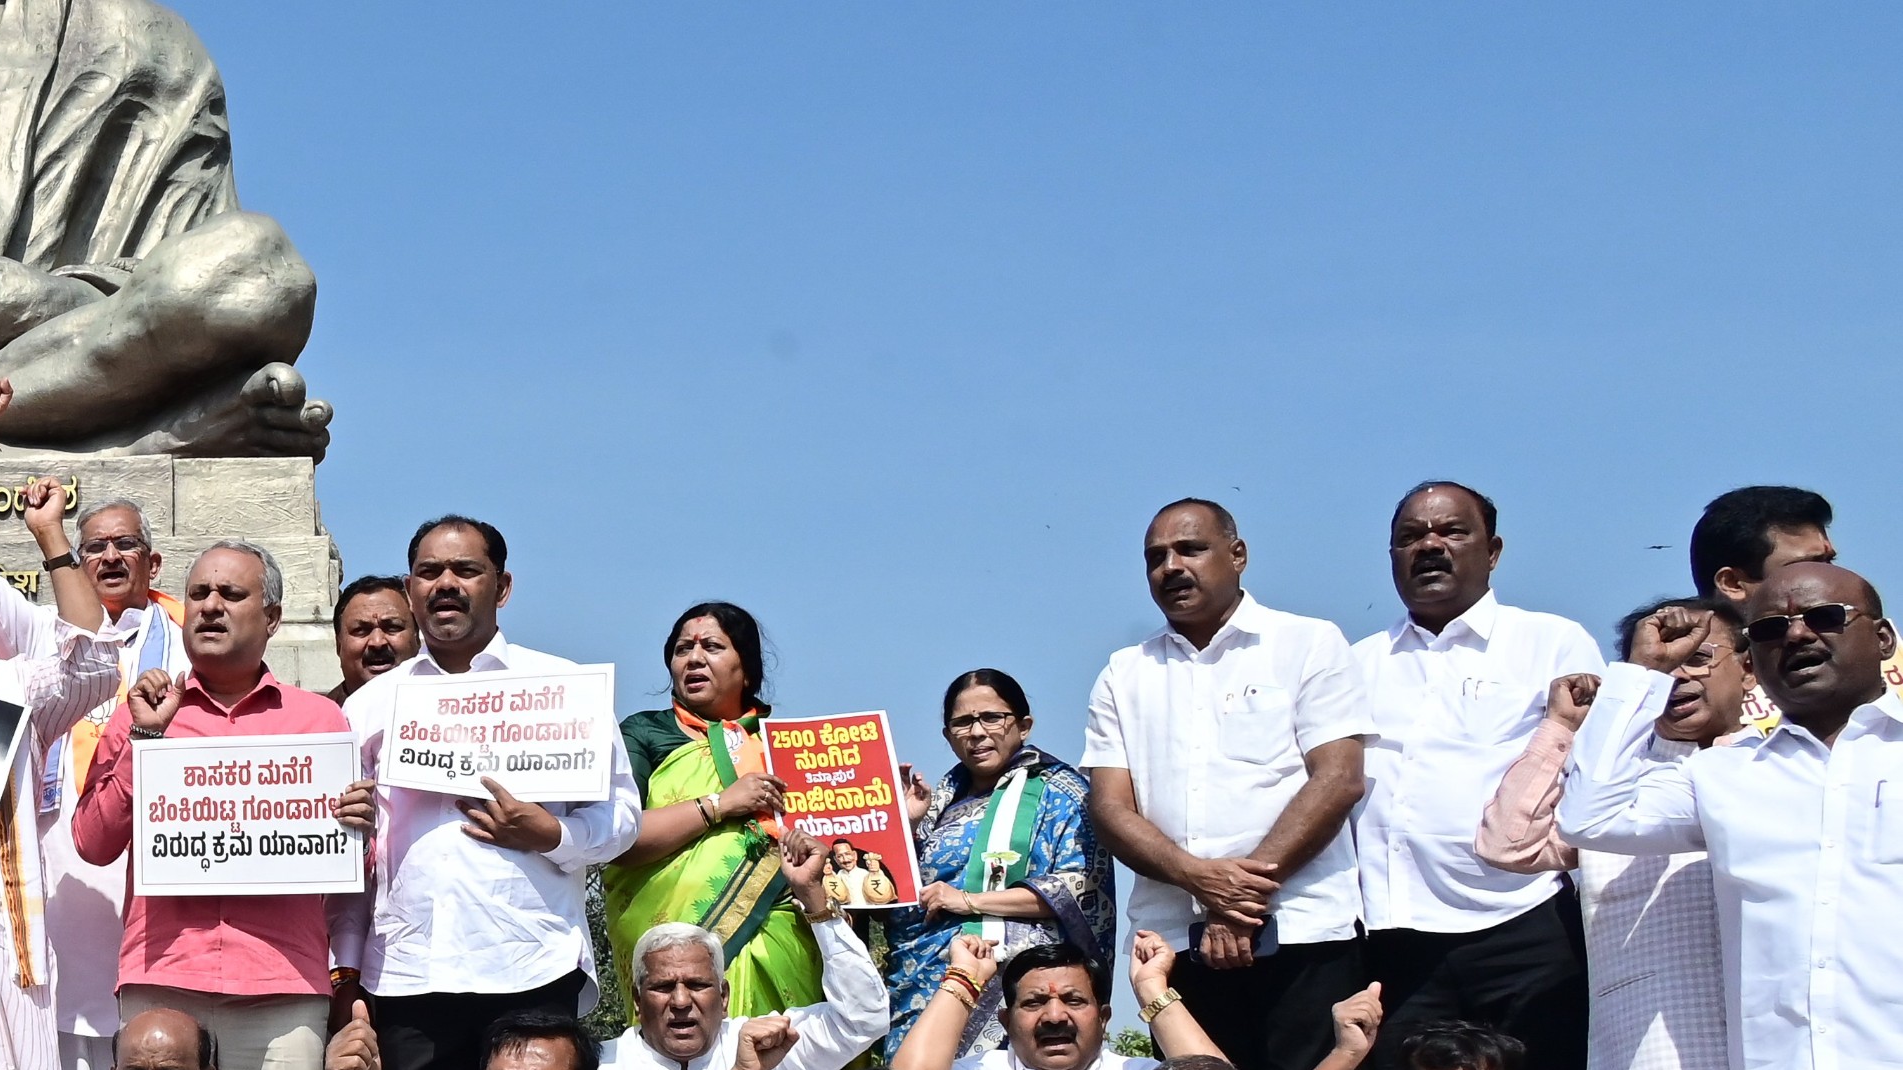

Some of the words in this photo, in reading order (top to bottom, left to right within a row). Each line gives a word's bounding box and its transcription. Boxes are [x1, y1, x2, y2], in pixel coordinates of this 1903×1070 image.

[437, 690, 504, 715] ಶಾಸಕರ
[509, 685, 565, 711] ಮನೆಗೆ
[772, 729, 816, 749] 2500
[819, 721, 879, 745] ಕೋಟಿ
[183, 760, 251, 787] ಶಾಸಕರ
[258, 756, 312, 785] ಮನೆಗೆ
[213, 831, 252, 862] ಕ್ರಮ
